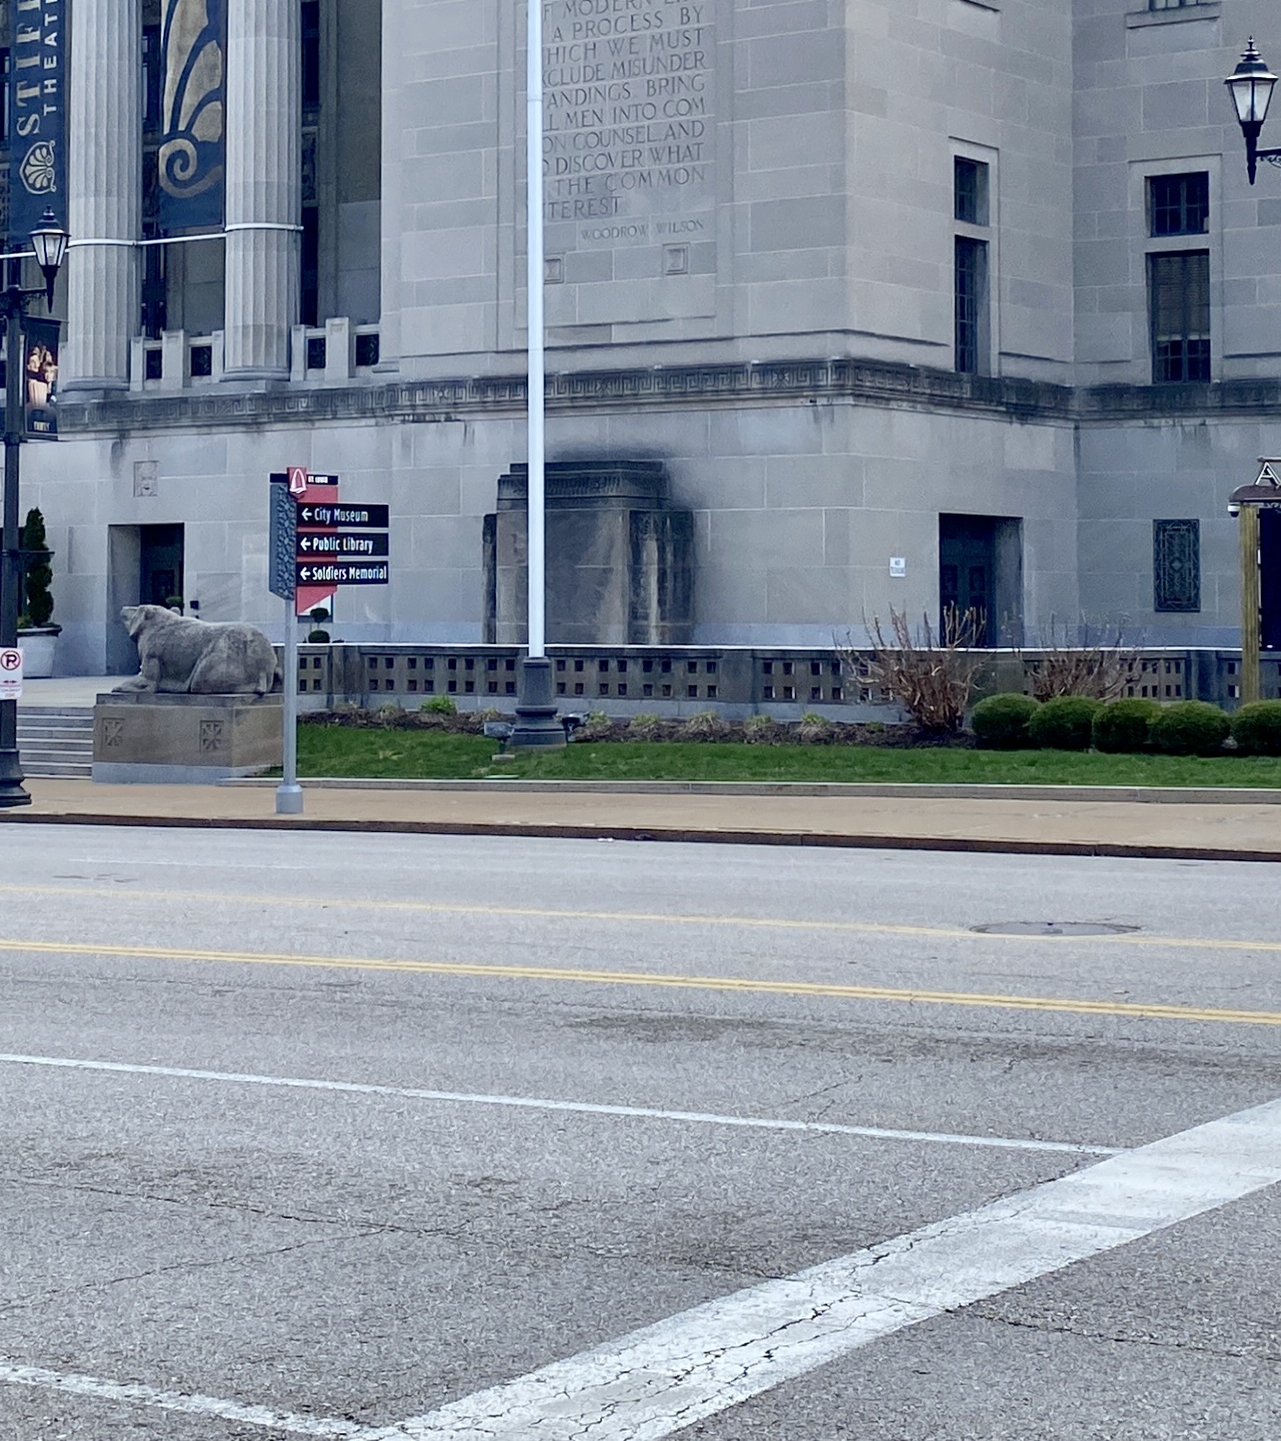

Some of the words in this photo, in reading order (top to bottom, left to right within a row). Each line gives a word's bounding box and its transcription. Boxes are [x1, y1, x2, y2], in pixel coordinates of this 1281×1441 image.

[553, 26, 563, 42] A
[573, 11, 664, 40] PROCESS
[680, 6, 703, 25] BY
[547, 42, 596, 65] HICH
[607, 37, 640, 56] WE
[650, 28, 704, 52] MUST
[542, 63, 605, 88] XCLUDE
[612, 50, 706, 79] MISUNDER
[543, 82, 631, 109] ANDINGS
[647, 73, 705, 97] BRING
[566, 108, 603, 128] MEN
[614, 103, 657, 124] INTO
[663, 97, 705, 116] COM
[543, 136, 567, 153] ON
[556, 149, 645, 175] DISCOVER
[649, 143, 704, 163] WHAT
[554, 176, 594, 196] THE
[605, 167, 705, 193] COMMON
[543, 196, 621, 219] TEREST
[582, 225, 649, 240] WOODROW
[656, 220, 704, 234] WILSON
[314, 507, 331, 525] City
[334, 508, 369, 522] Museum
[312, 537, 340, 551] Public
[342, 537, 374, 555] Library
[312, 565, 347, 581] Soldiers
[348, 565, 387, 580] Memorial
